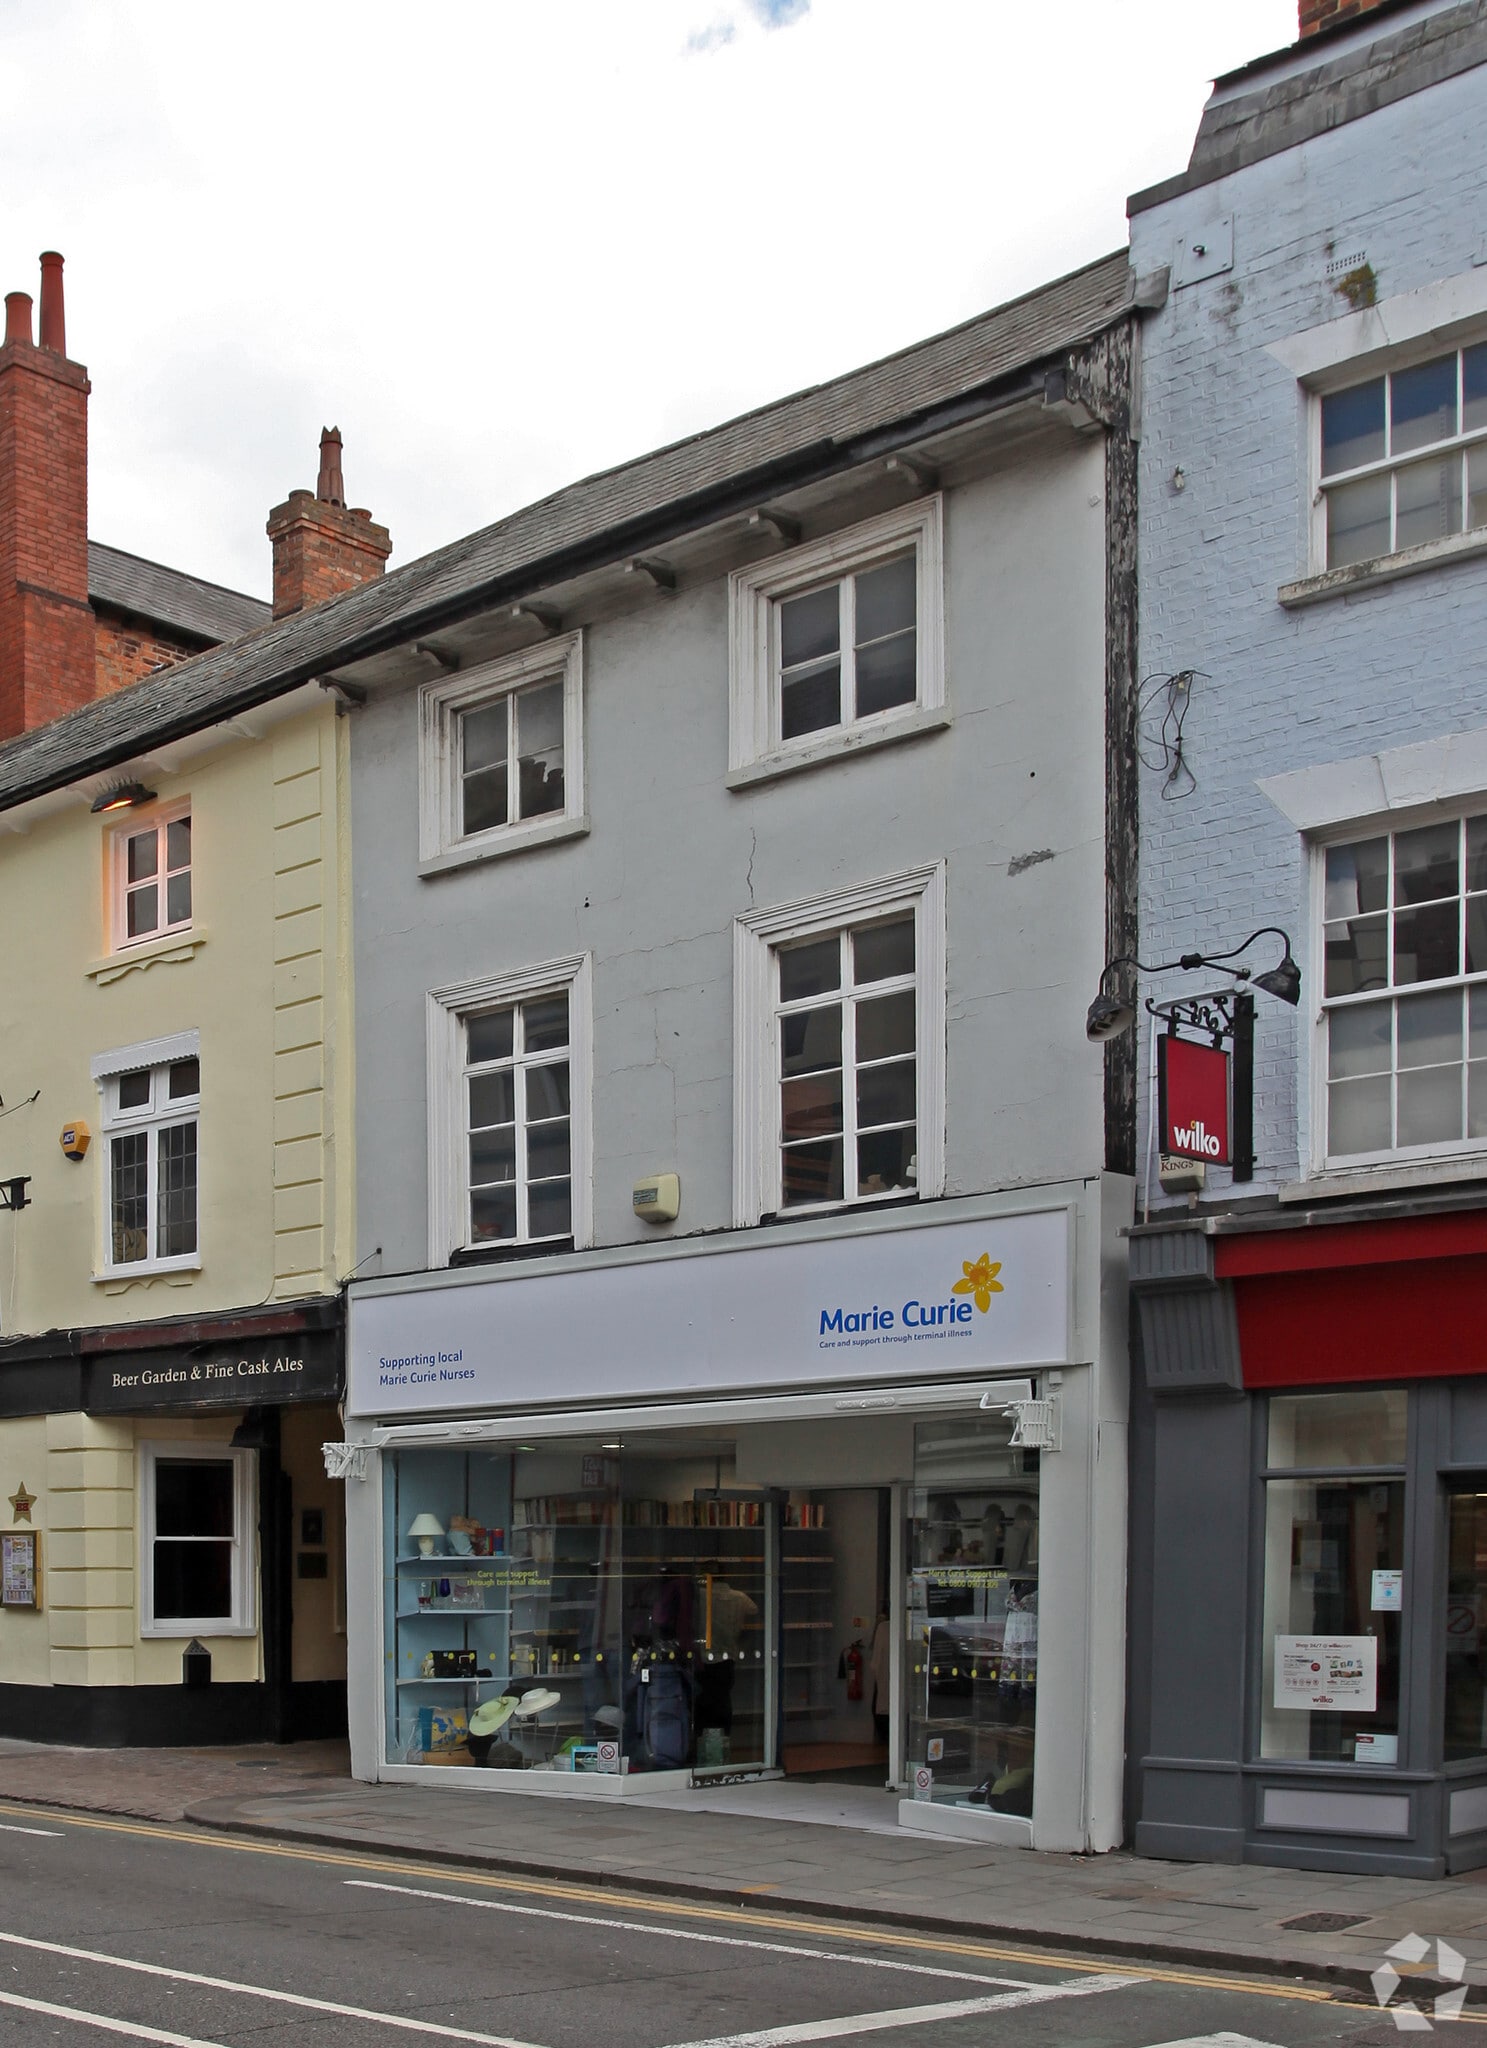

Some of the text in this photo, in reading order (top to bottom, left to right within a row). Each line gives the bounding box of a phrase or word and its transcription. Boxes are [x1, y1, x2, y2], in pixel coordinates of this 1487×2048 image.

[1173, 1120, 1220, 1156] wilko
[1161, 1160, 1194, 1172] KINGS
[819, 1298, 973, 1335] Marie Curie
[819, 1330, 972, 1349] Care and support through terminal illness
[379, 1349, 463, 1370] Supporting local
[112, 1357, 303, 1387] Beer Garden & Fine Cask Ales
[379, 1369, 475, 1385] Marie Curie Nurses
[467, 1578, 495, 1587] through
[496, 1578, 526, 1586] terminal
[477, 1570, 539, 1579] Care and support
[966, 1569, 992, 1580] Support
[993, 1570, 1008, 1578] Line
[1312, 1695, 1334, 1703] wilko
